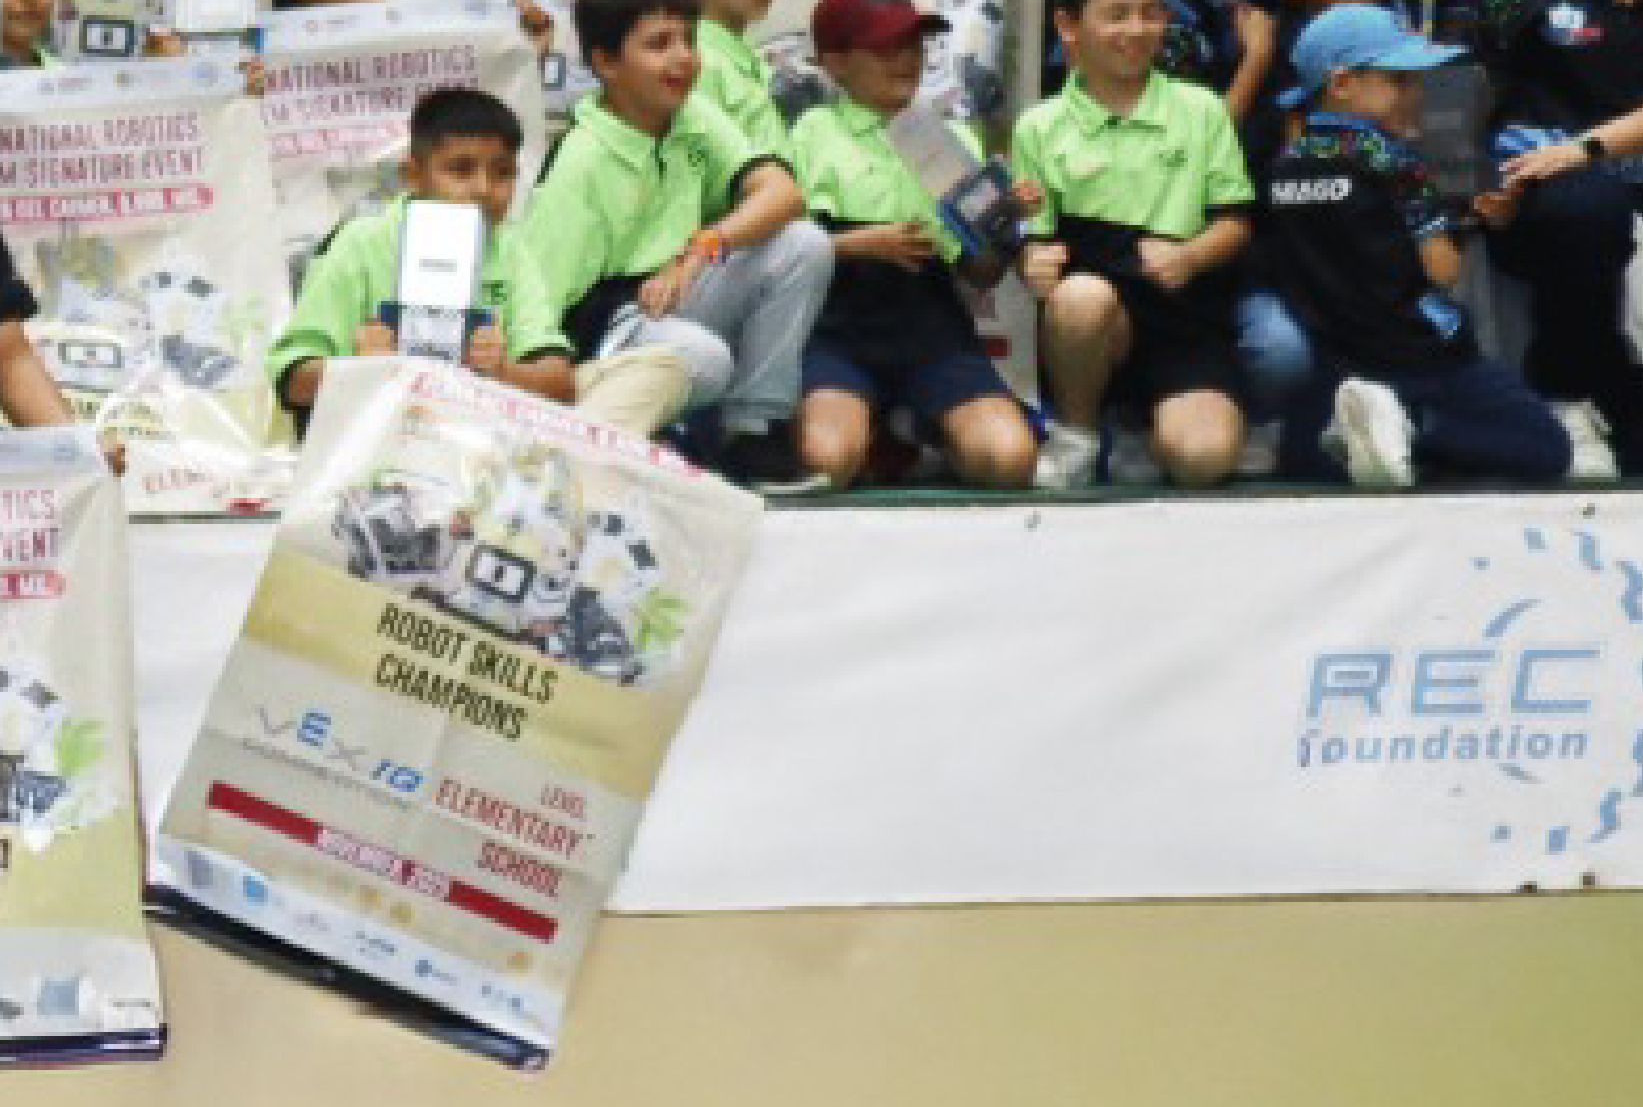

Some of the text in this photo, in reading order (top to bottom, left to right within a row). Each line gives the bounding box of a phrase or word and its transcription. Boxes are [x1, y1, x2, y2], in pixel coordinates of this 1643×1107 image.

[142, 148, 204, 179] EVENT
[375, 603, 560, 706] ROBOT SKILLS
[1306, 650, 1600, 720] REC
[374, 652, 529, 742] CHAMPIONS
[370, 758, 424, 793] IQ
[1297, 725, 1590, 768] foundation
[435, 777, 584, 859] ELEMENTARY
[476, 841, 565, 899] SCHOOL
